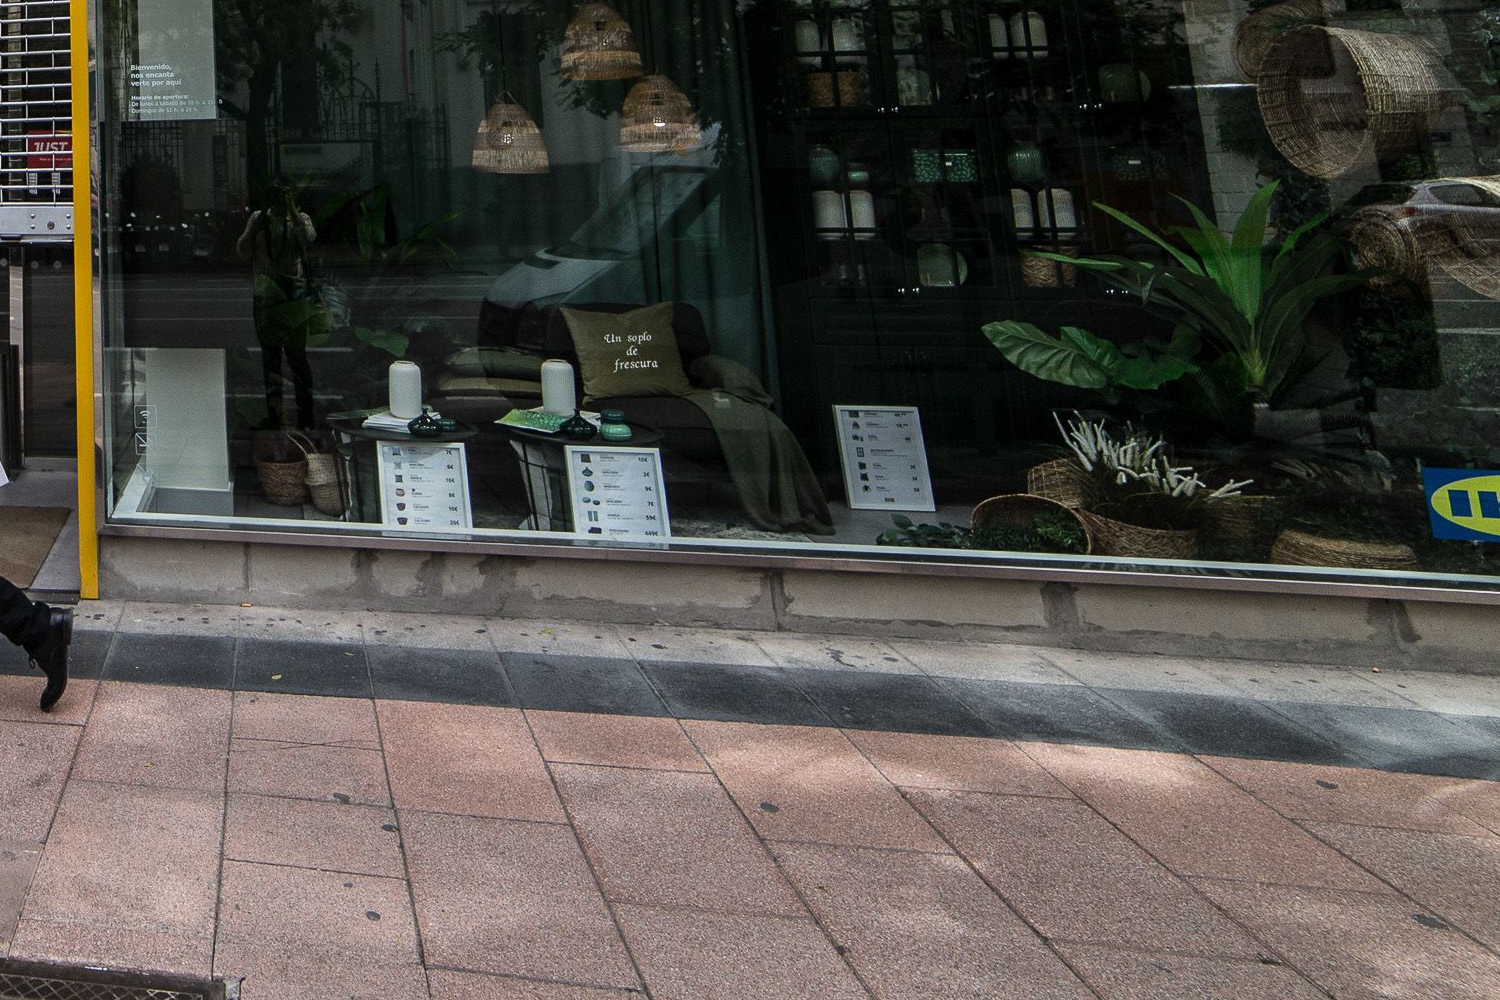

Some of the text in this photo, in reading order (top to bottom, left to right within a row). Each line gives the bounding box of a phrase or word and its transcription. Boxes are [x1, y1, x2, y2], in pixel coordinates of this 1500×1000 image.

[604, 332, 652, 344] Un soplo
[626, 345, 638, 356] de
[613, 359, 658, 373] frescura
